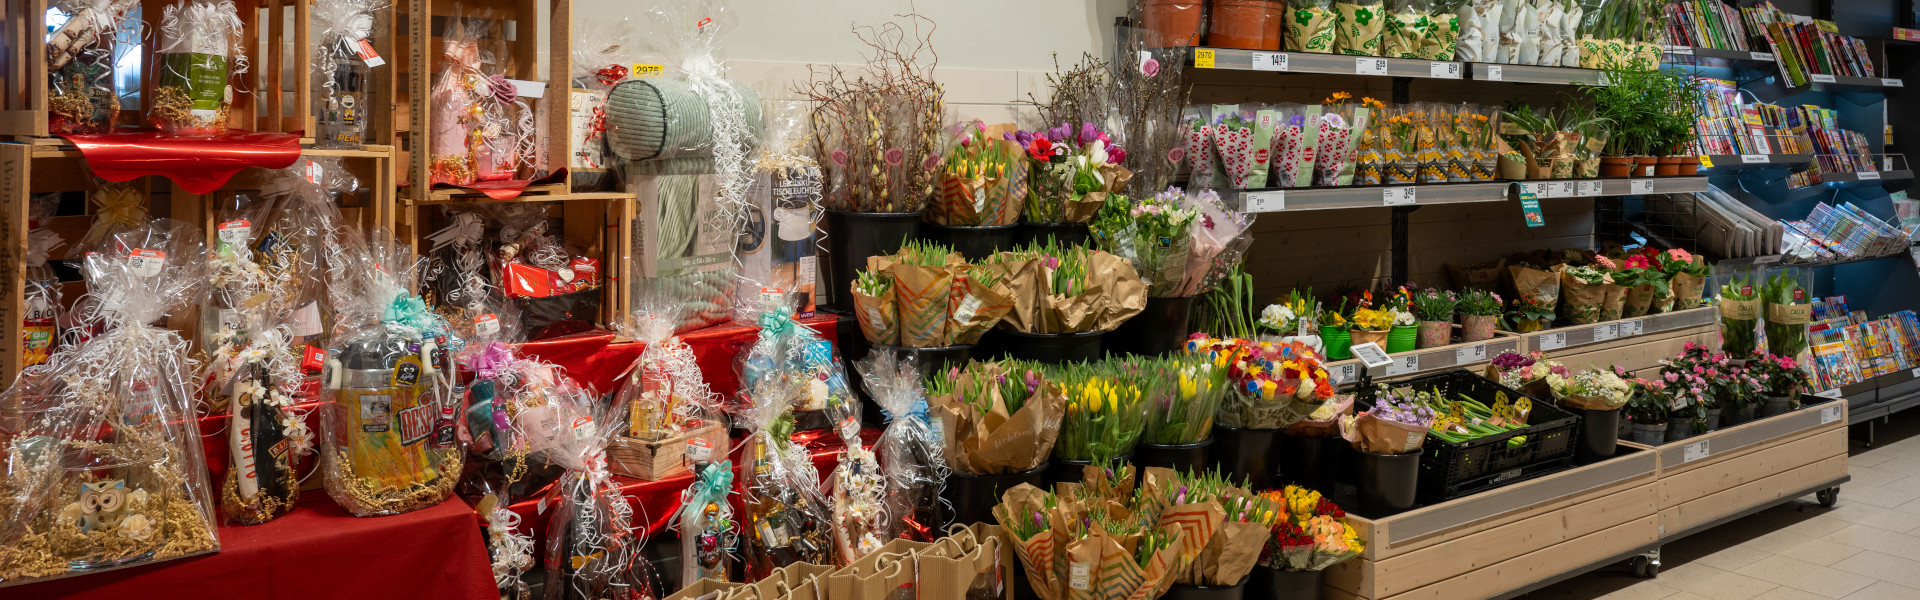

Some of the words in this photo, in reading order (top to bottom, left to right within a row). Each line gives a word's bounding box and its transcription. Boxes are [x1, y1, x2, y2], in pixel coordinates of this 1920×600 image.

[1197, 51, 1212, 59] 2970
[636, 66, 660, 75] 2975
[2, 160, 14, 204] Wein
